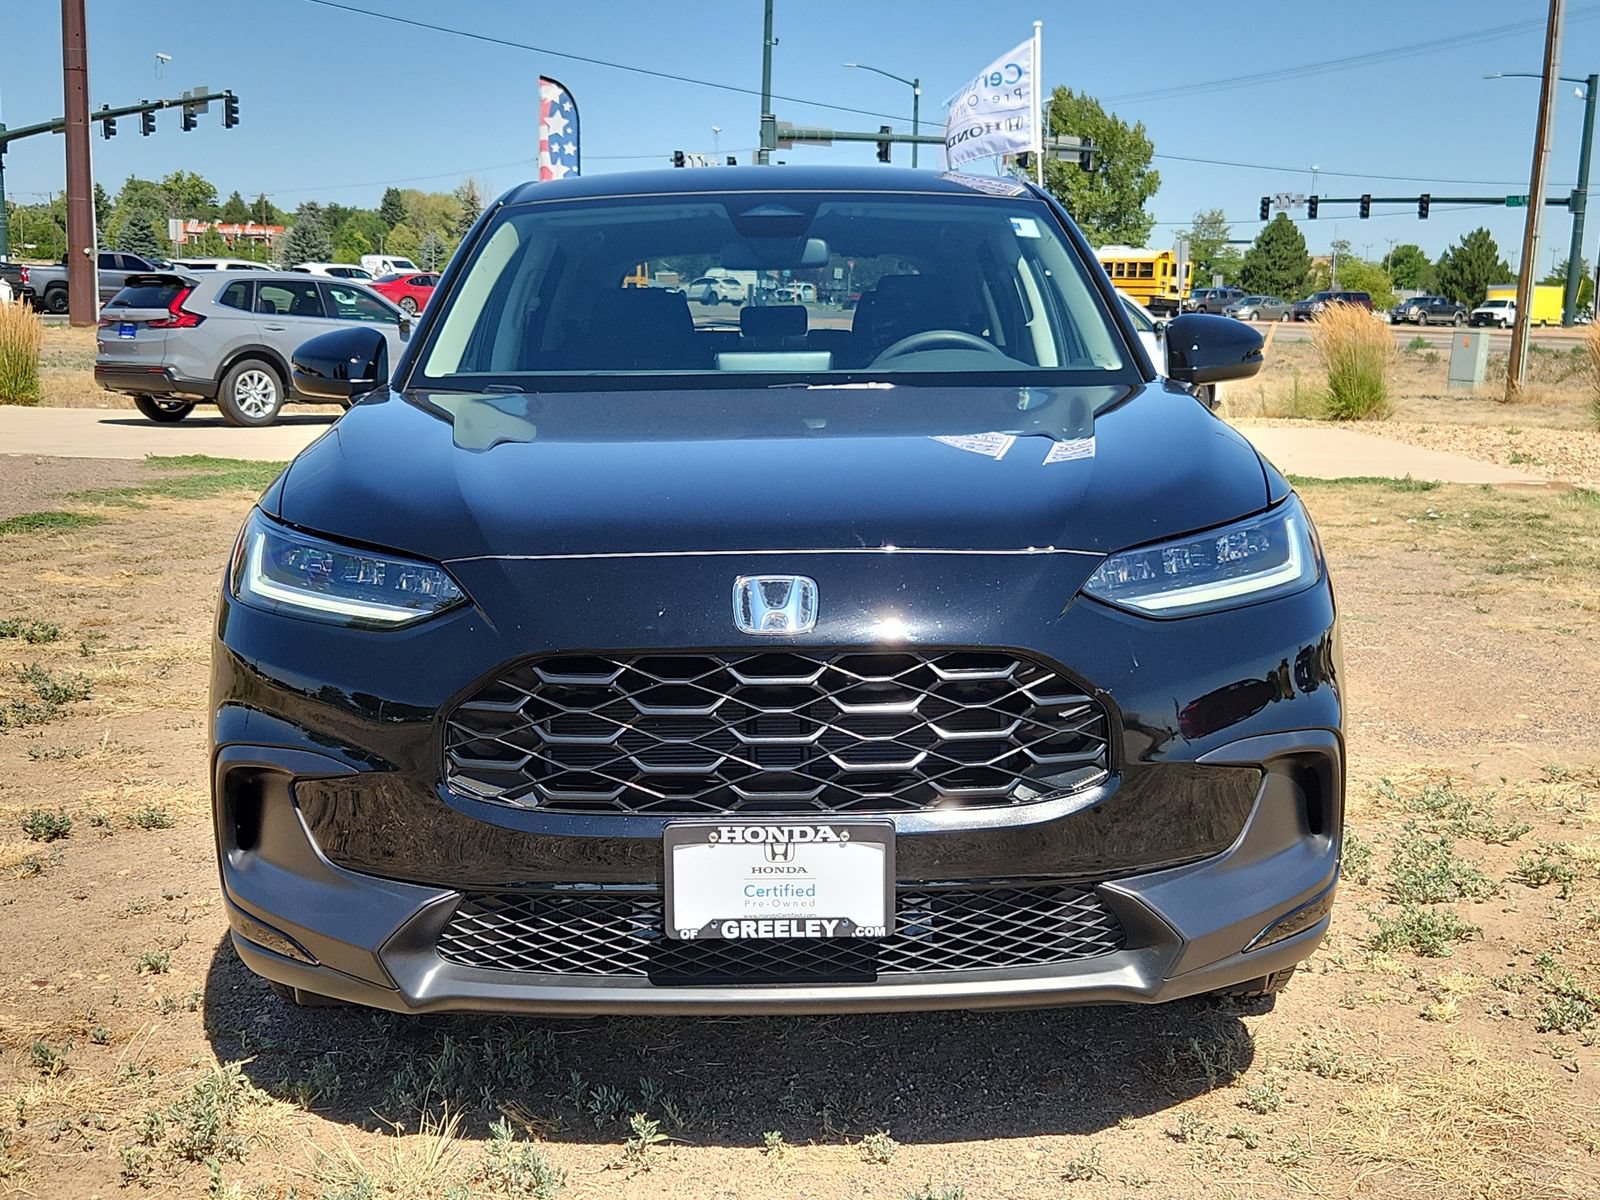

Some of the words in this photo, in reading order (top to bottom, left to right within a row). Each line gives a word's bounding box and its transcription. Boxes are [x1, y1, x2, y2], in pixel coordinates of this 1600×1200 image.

[717, 825, 841, 843] HONDA
[751, 866, 809, 874] HONDA
[743, 884, 816, 897] Certified
[744, 899, 816, 908] Pre-Owned
[679, 928, 699, 940] OF
[720, 919, 839, 939] GREELEY
[851, 926, 886, 938] .COM
